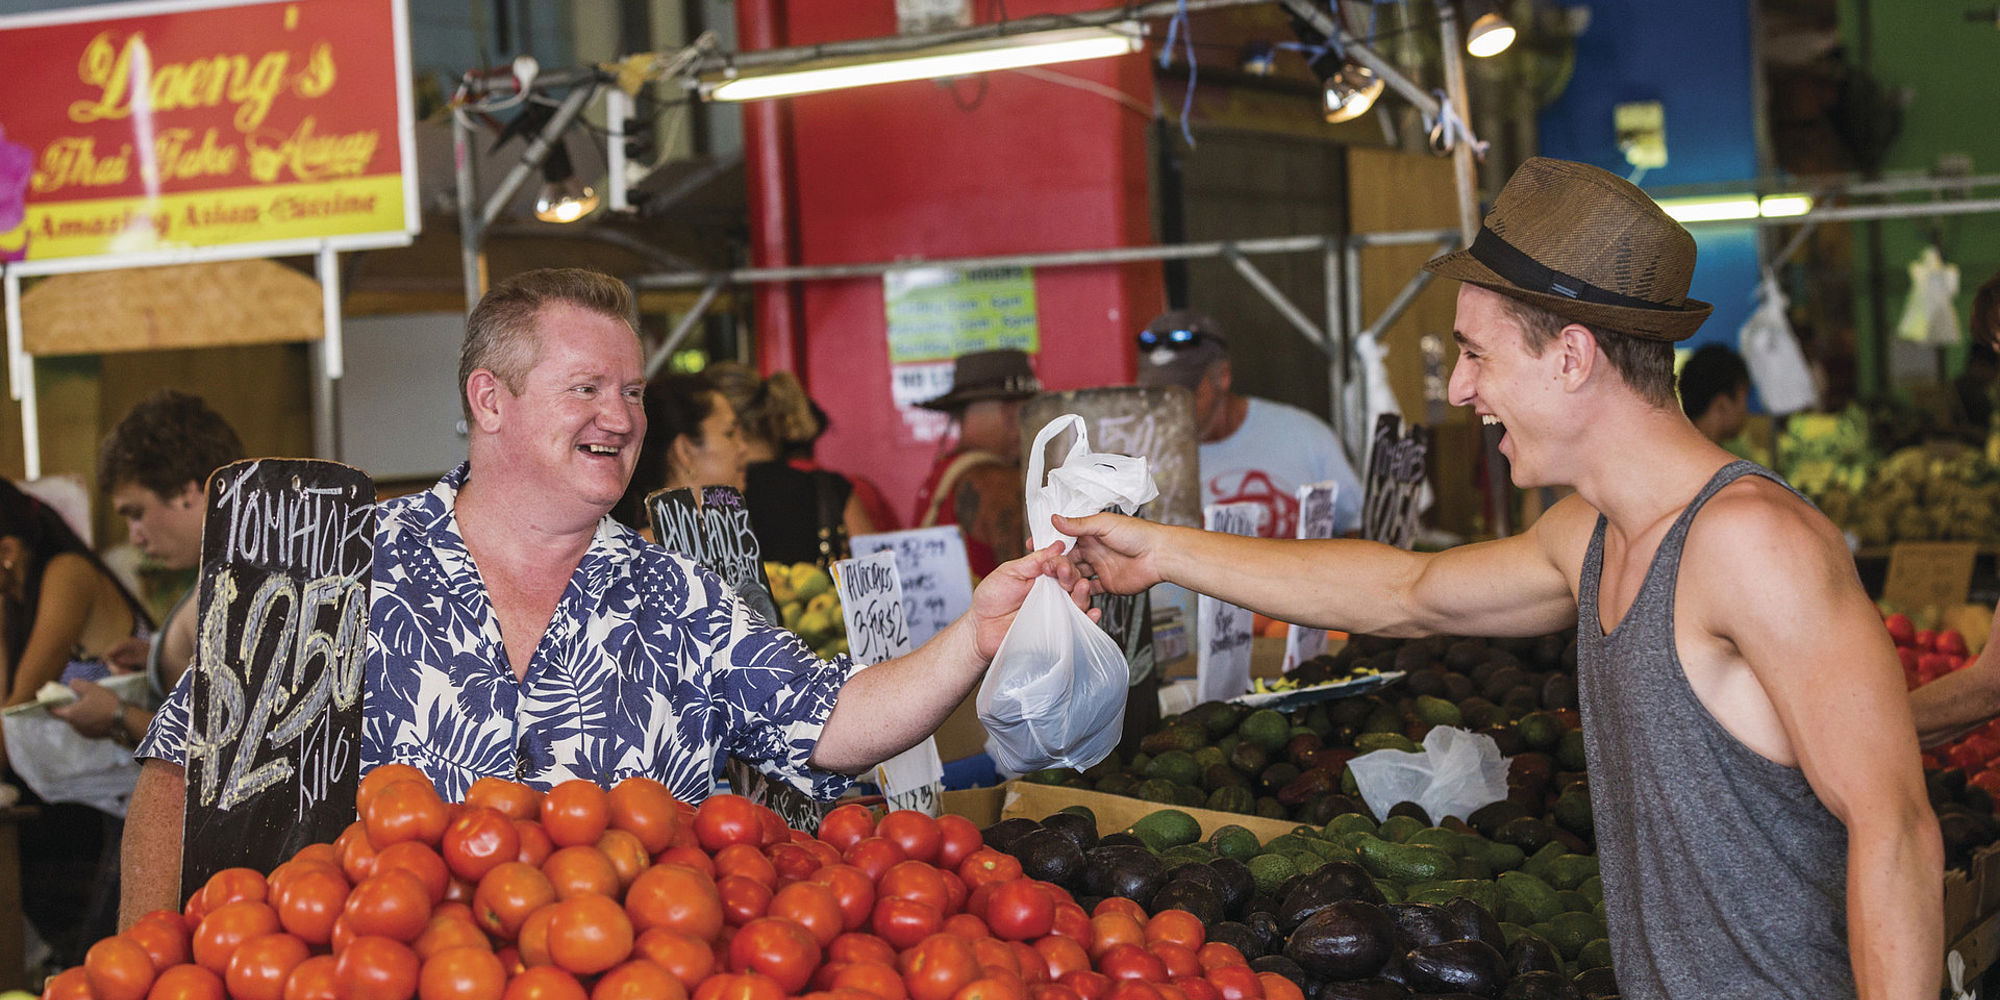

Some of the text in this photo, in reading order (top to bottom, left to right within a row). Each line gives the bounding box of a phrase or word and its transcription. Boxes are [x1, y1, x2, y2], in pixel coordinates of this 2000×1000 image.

[31, 117, 379, 192] Thai Take Away
[38, 203, 171, 239] Amazig
[184, 198, 261, 227] Asian
[194, 570, 367, 812] $2.50
